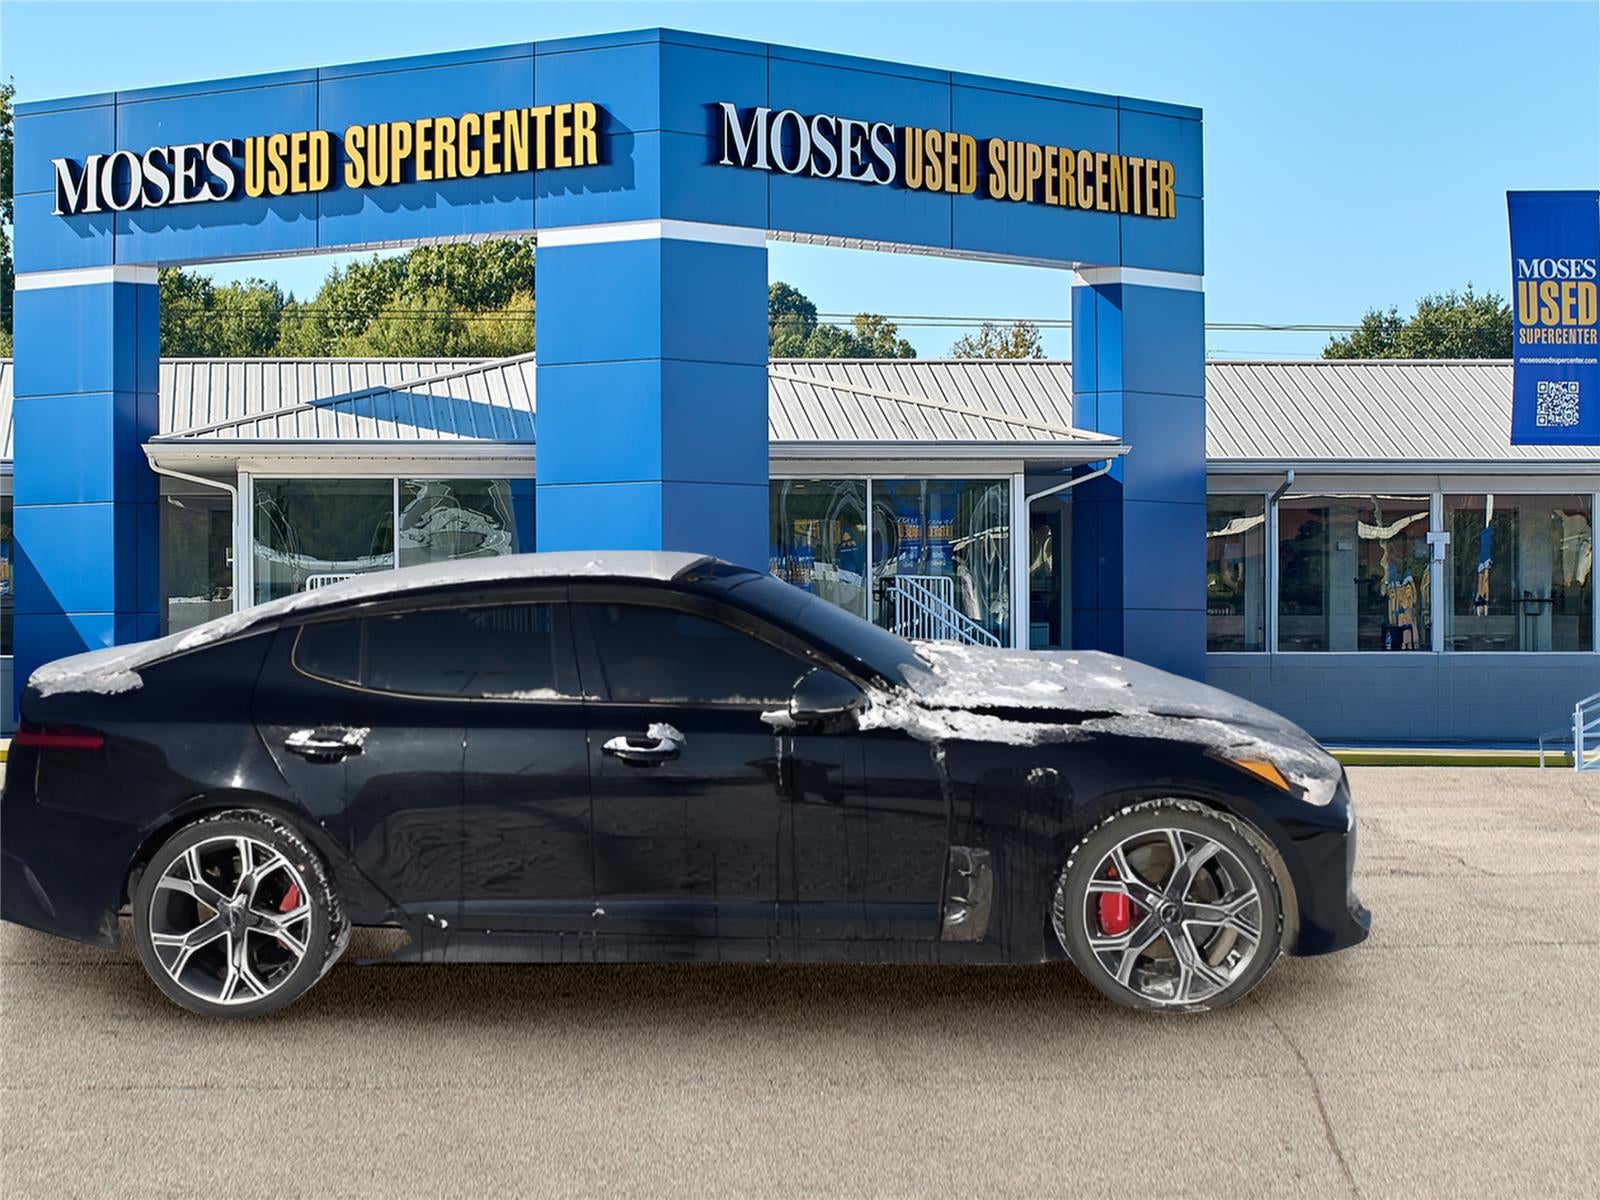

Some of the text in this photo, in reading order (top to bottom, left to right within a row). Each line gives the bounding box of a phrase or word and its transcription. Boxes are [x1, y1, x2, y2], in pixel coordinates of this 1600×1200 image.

[52, 101, 598, 216] MOSES USED SUPERCENTER
[718, 101, 1176, 218] MOSES USED SUPERCENTER
[1517, 258, 1597, 280] MOSES
[1518, 281, 1598, 326] USED
[1519, 328, 1598, 345] SUPERCENTER
[1519, 357, 1598, 365] mosesusedsupercenter.com
